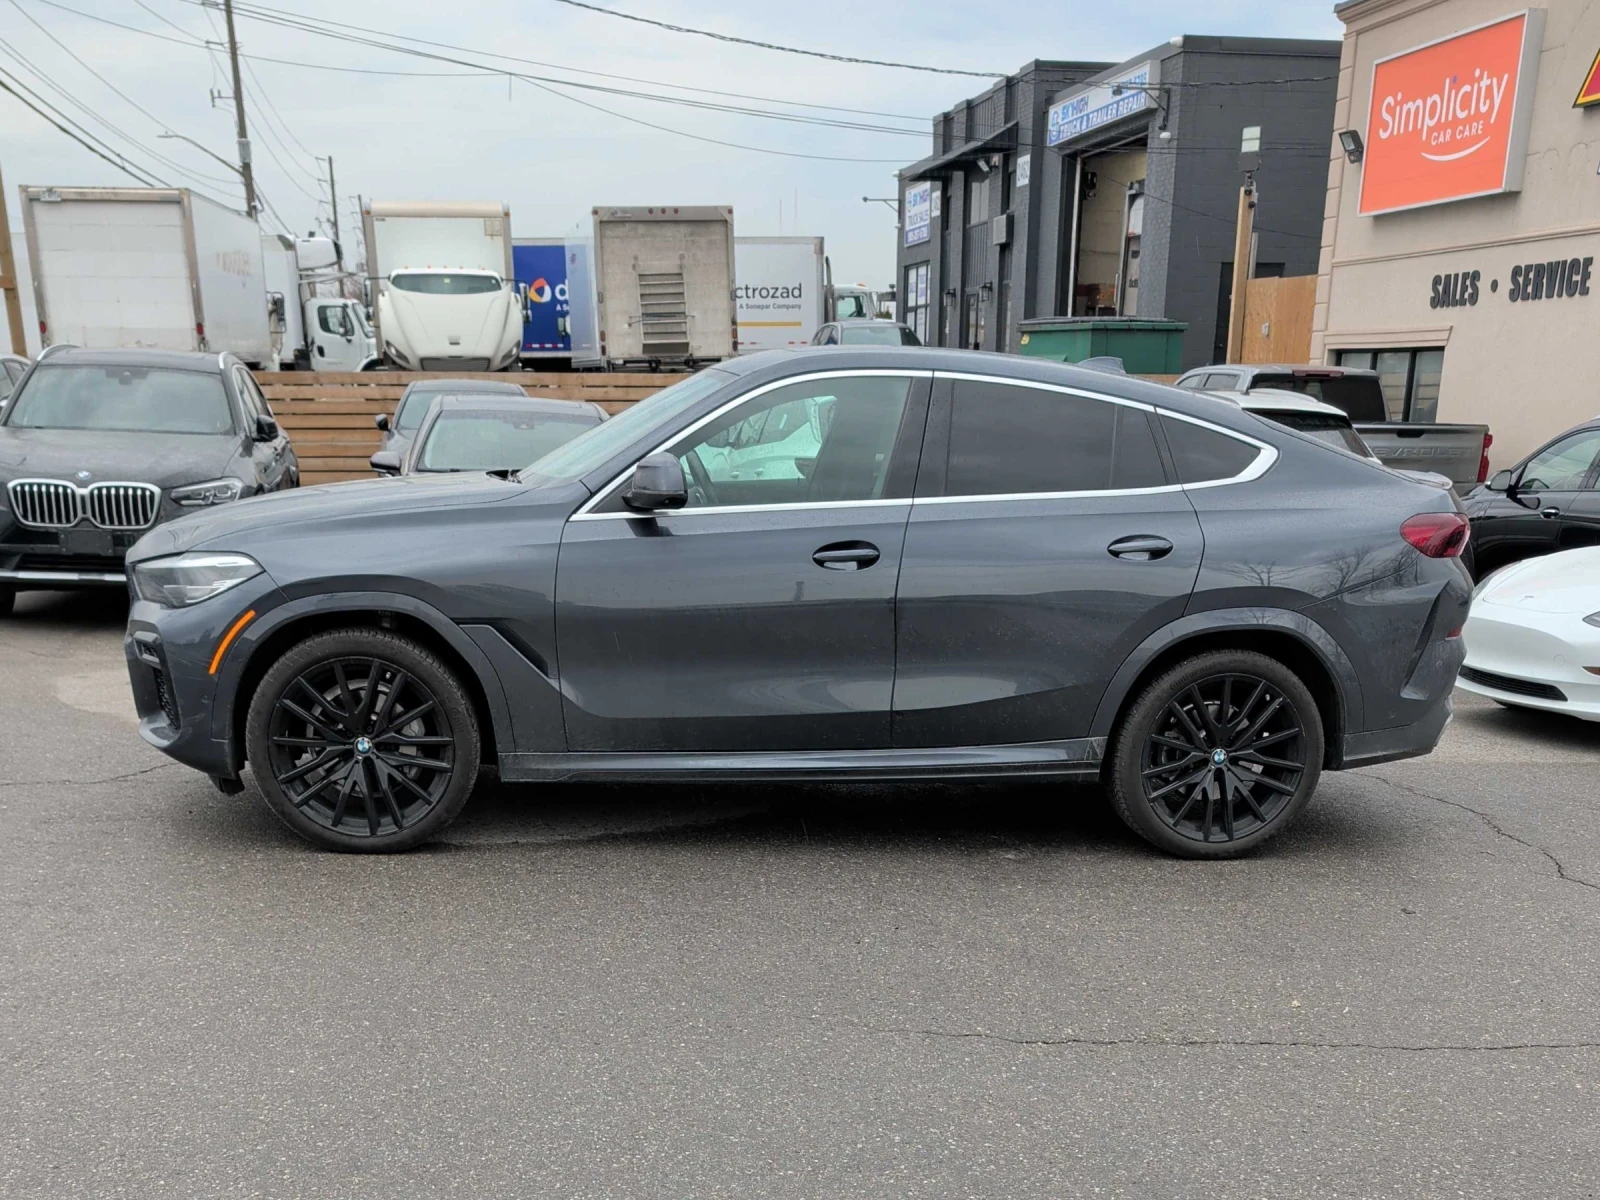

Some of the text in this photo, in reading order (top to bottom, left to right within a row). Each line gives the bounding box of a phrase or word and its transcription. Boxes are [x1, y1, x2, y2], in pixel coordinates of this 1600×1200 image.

[1060, 119, 1081, 138] TRUCK
[1089, 105, 1117, 126] TRAILER
[1118, 93, 1146, 114] REPAIR
[1379, 68, 1508, 141] Simplicity
[1431, 120, 1483, 145] CAR CARE
[735, 282, 802, 299] ctrozad
[1430, 257, 1593, 309] SALES SERVICE
[1372, 446, 1475, 457] EVROLET
